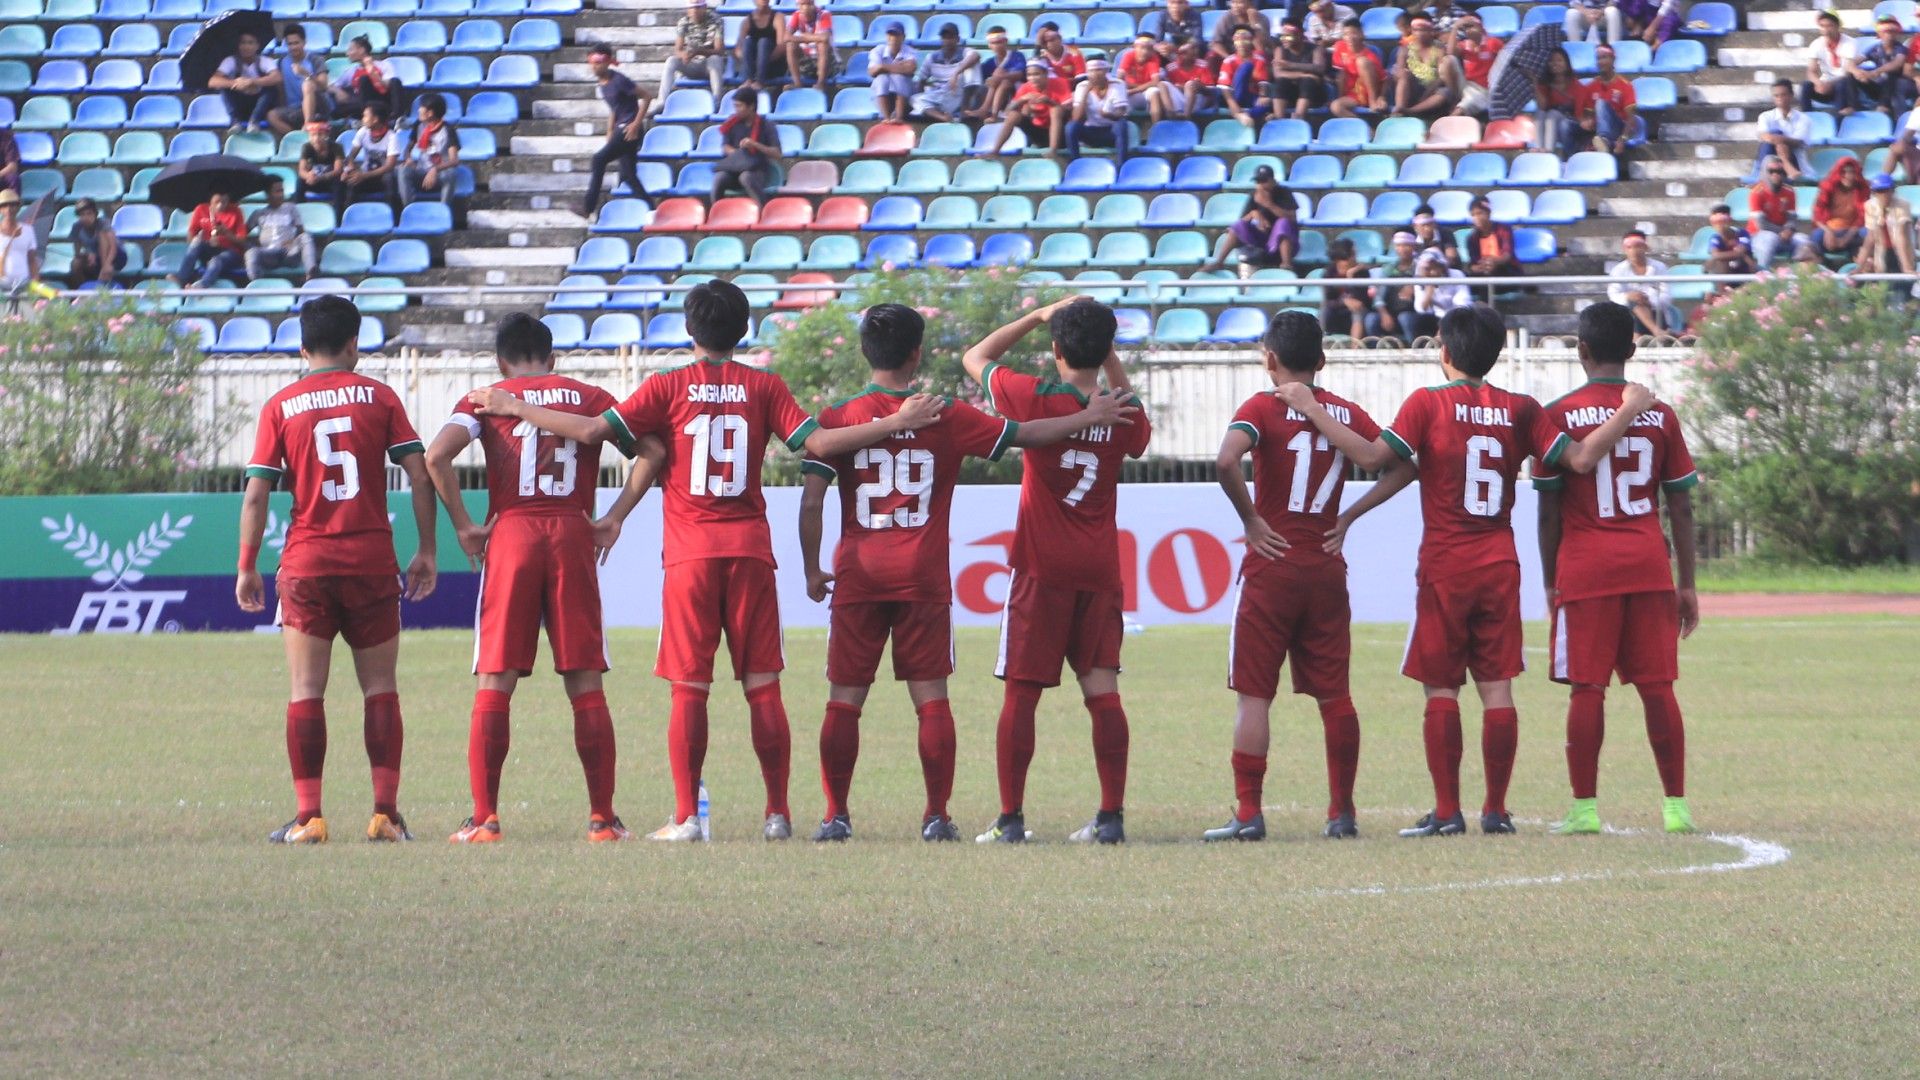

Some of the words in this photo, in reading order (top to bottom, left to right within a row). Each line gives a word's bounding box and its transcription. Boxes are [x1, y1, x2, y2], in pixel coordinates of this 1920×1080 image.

[281, 386, 375, 419] NURHIDAYAT
[523, 388, 582, 406] IRIANTO
[688, 384, 747, 403] SAGHARA
[1471, 406, 1513, 426] IQBAL
[1565, 406, 1665, 429] MARASESSY
[313, 416, 360, 501] 5
[512, 420, 578, 496] 13
[684, 414, 748, 497] 19
[854, 448, 934, 529] 29
[1060, 449, 1099, 507] 7
[1287, 431, 1345, 513] 17
[1464, 435, 1503, 516] 6
[1595, 436, 1654, 518] 12
[50, 590, 188, 636] FBT
